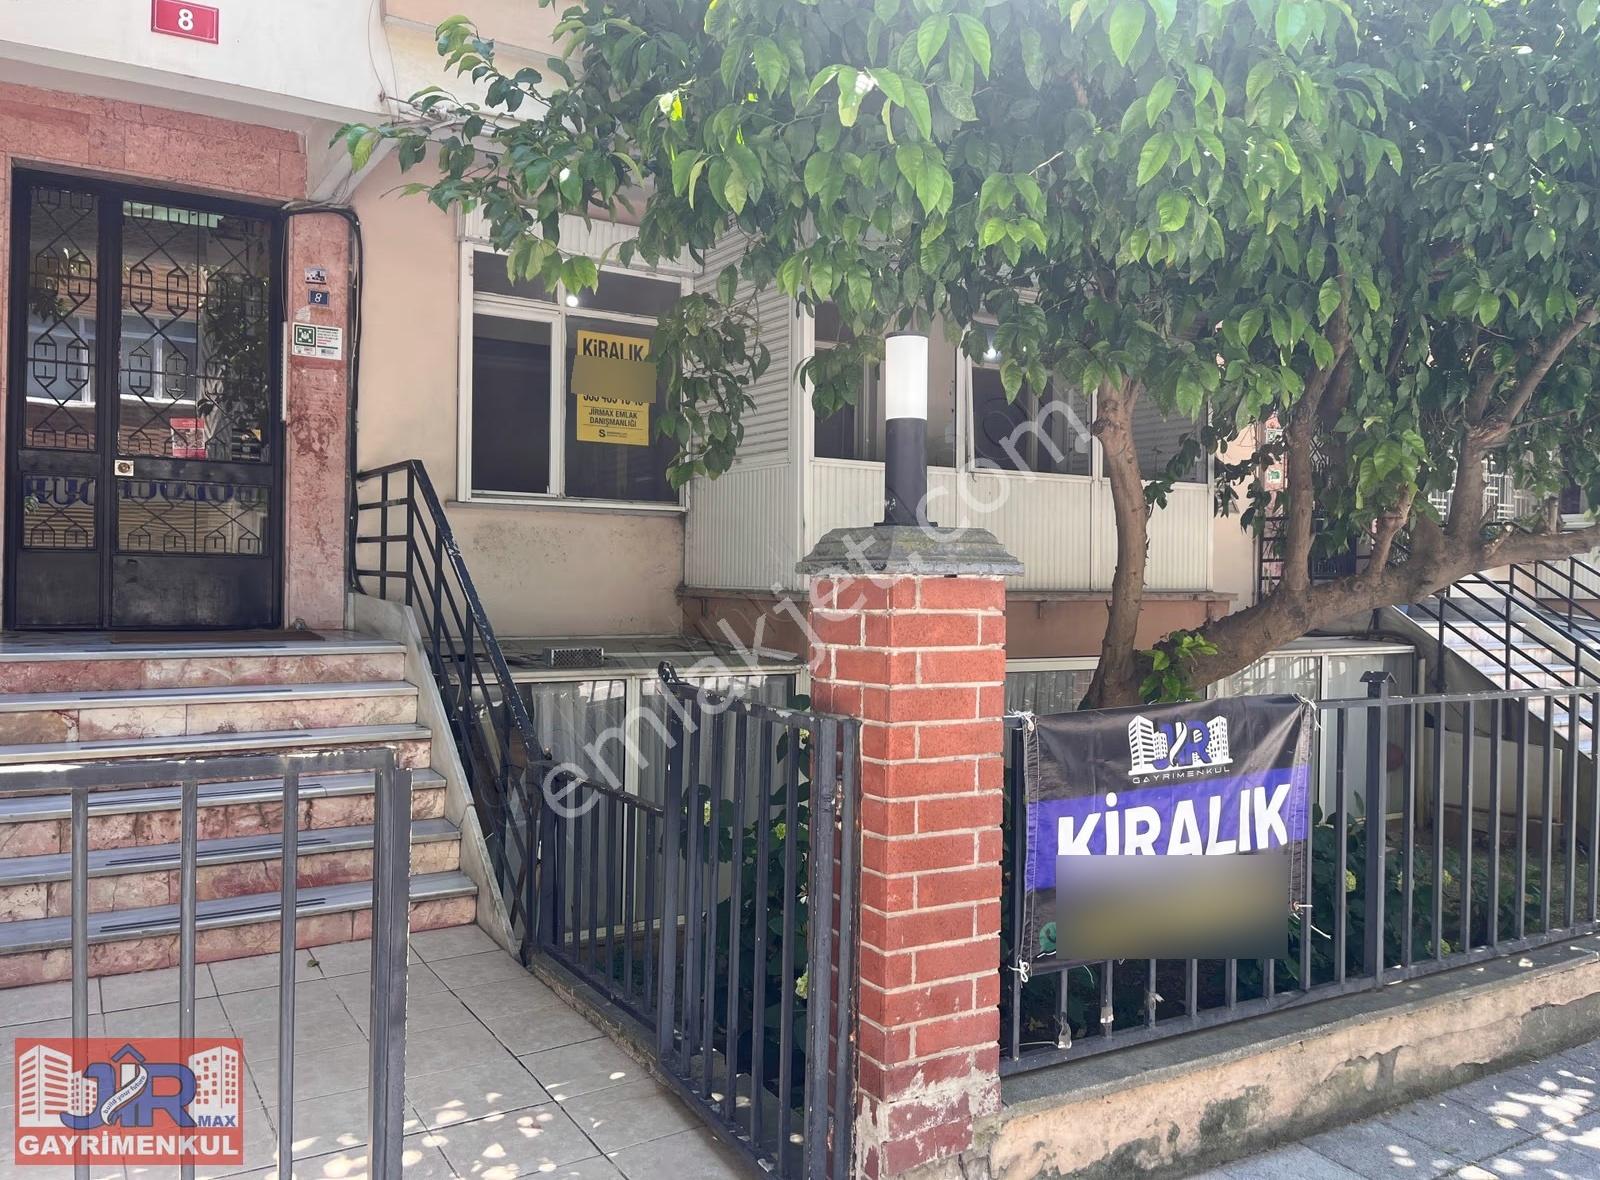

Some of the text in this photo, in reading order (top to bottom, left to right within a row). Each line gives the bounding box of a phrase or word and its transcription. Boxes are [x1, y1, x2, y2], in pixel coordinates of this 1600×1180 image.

[178, 8, 194, 31] 8
[314, 292, 322, 302] 8
[615, 411, 638, 419] EMLAK
[1132, 766, 1230, 784] GAYRIMENKUL
[1057, 783, 1291, 856] KİRALIK
